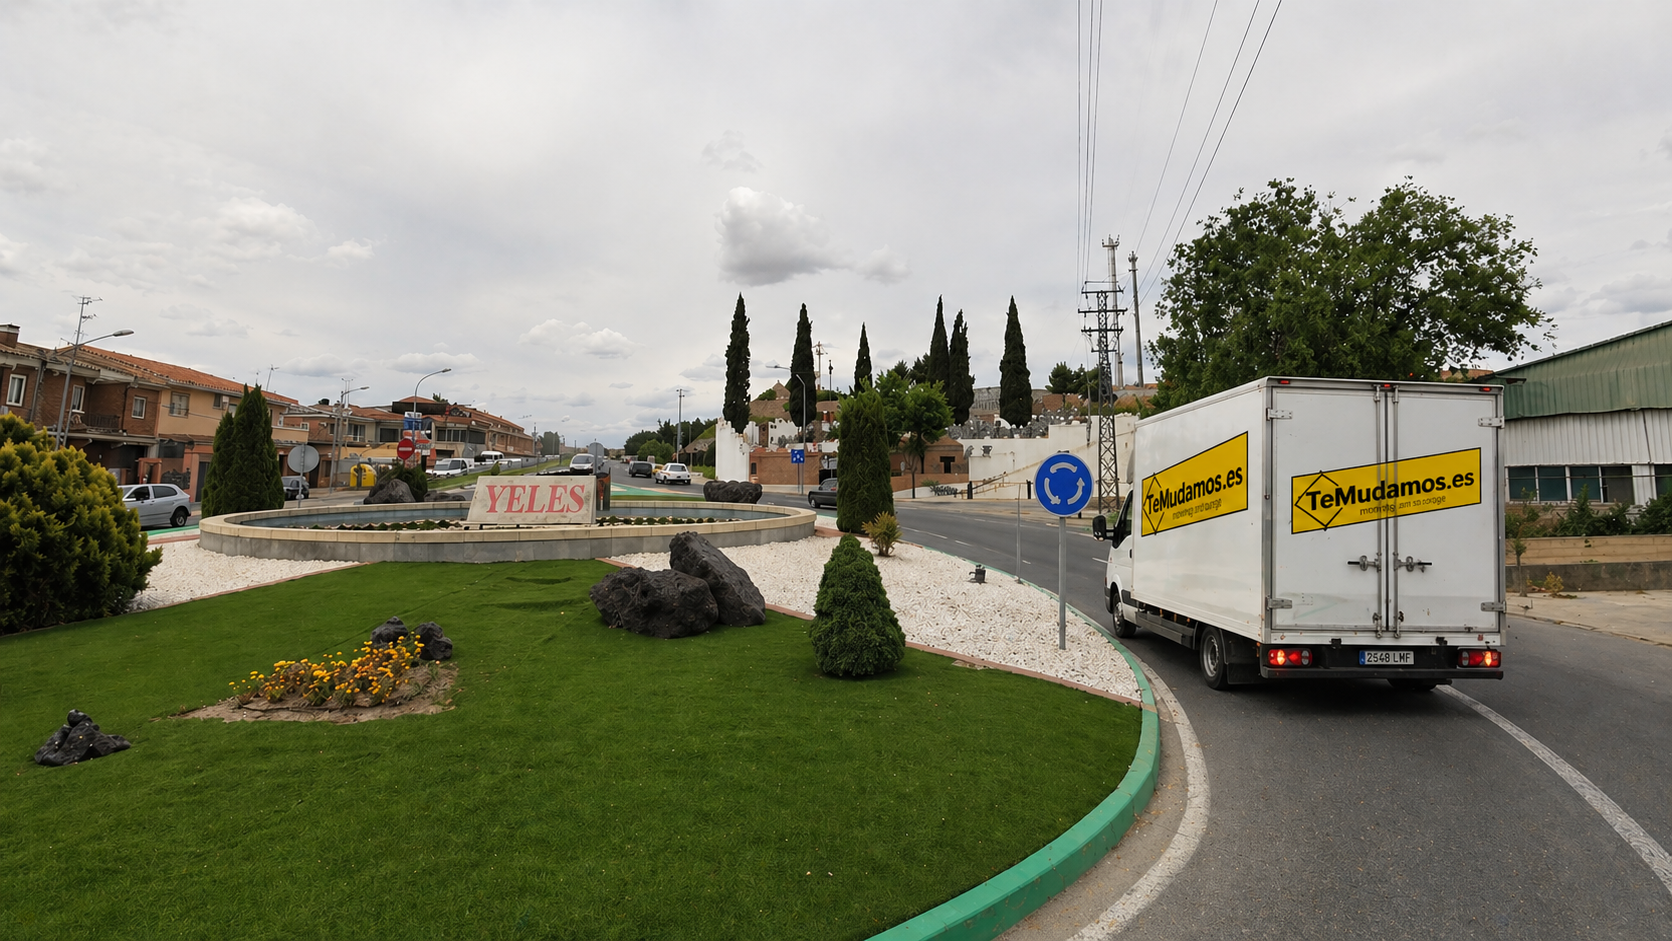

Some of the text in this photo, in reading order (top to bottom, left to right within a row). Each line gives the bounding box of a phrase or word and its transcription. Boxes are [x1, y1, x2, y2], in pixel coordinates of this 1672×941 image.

[486, 484, 585, 513] YELES
[1146, 466, 1243, 515] TeMudamos.es
[1306, 472, 1475, 511] TeMudamos.es
[1367, 652, 1390, 663] 2548
